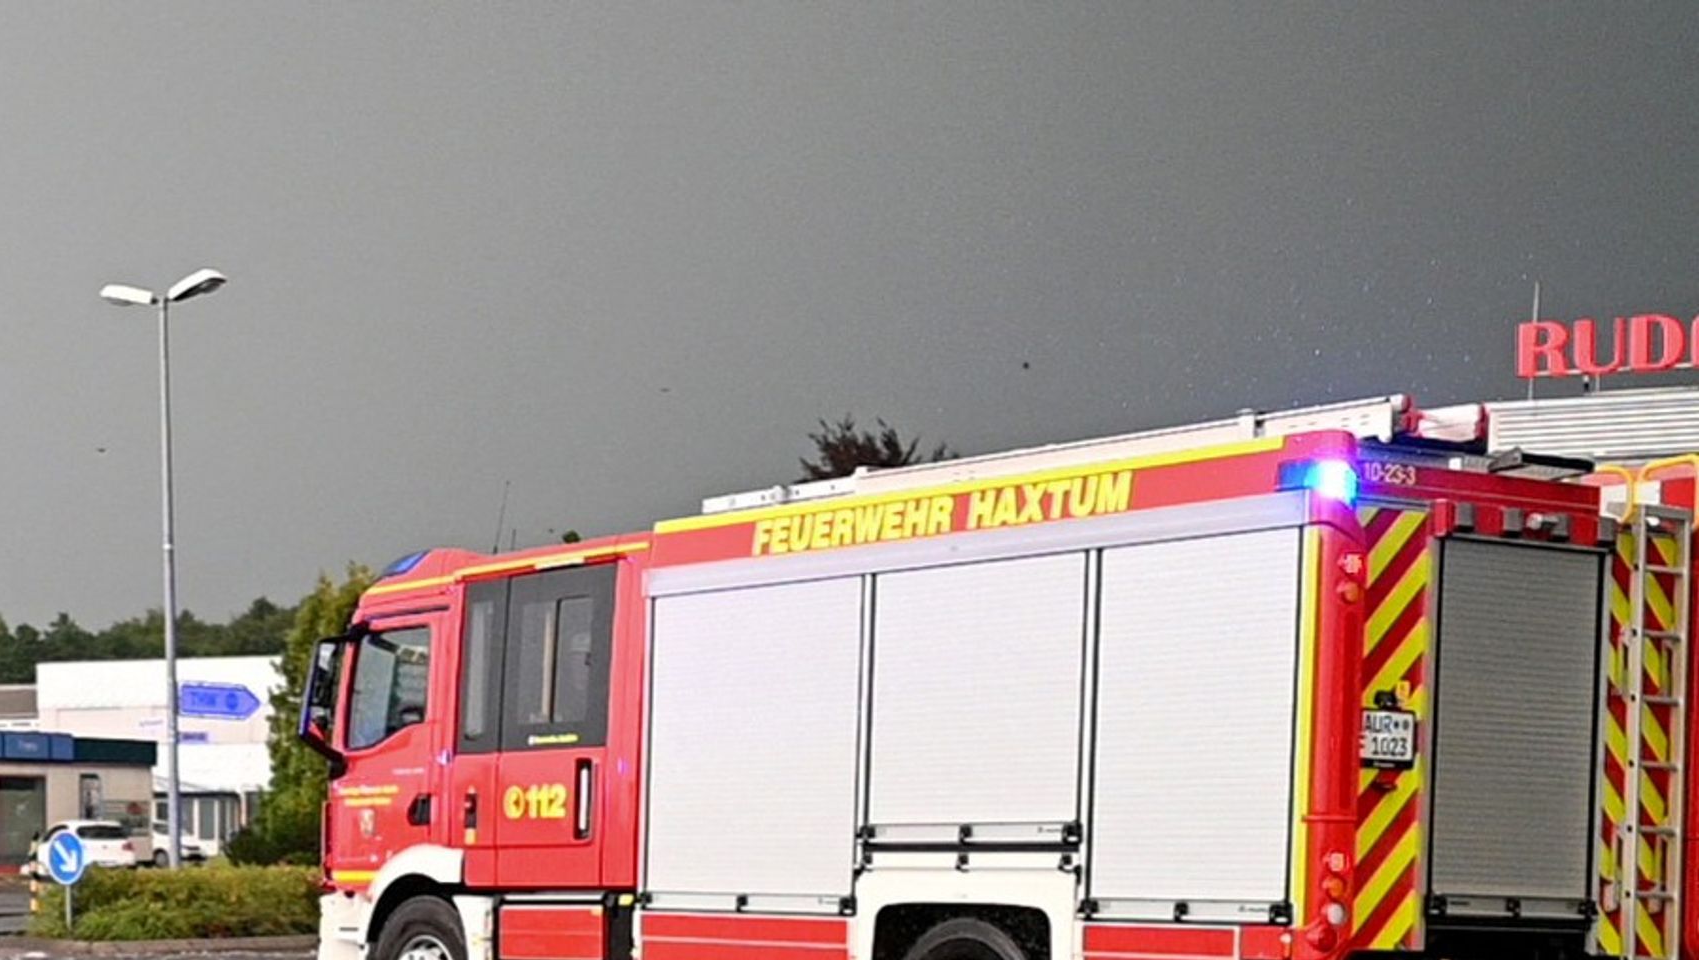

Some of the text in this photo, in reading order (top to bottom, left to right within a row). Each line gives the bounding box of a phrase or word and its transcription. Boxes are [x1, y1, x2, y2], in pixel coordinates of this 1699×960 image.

[1516, 315, 1699, 378] RUD
[752, 470, 1132, 556] FEUERWEHR HAXTUM
[1372, 736, 1408, 757] 1023
[526, 784, 567, 819] 112
